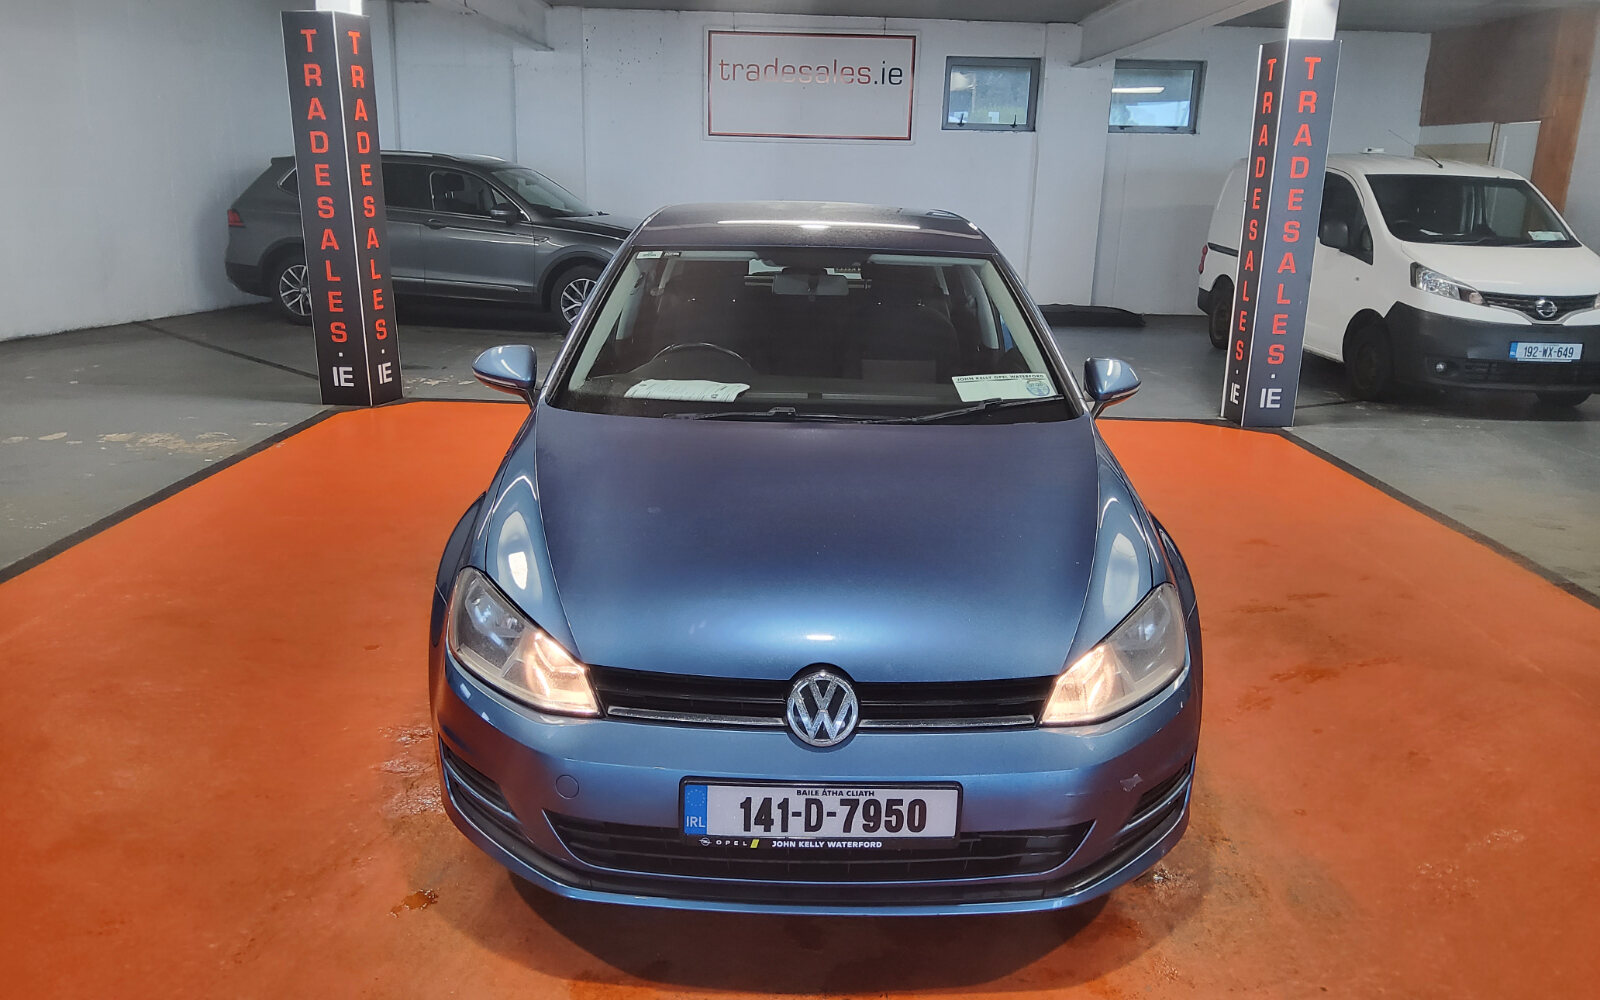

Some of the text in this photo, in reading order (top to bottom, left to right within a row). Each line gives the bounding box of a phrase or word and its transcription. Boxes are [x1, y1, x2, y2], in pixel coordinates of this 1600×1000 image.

[718, 57, 904, 86] tradesales.ie
[1523, 345, 1575, 358] 192-WX-649
[821, 788, 844, 797] ÁTHA
[686, 815, 706, 828] IRL
[740, 796, 927, 834] 141-D-7950
[715, 839, 748, 847] OPEL
[771, 840, 883, 849] JOHN KELLY WATERFORD
